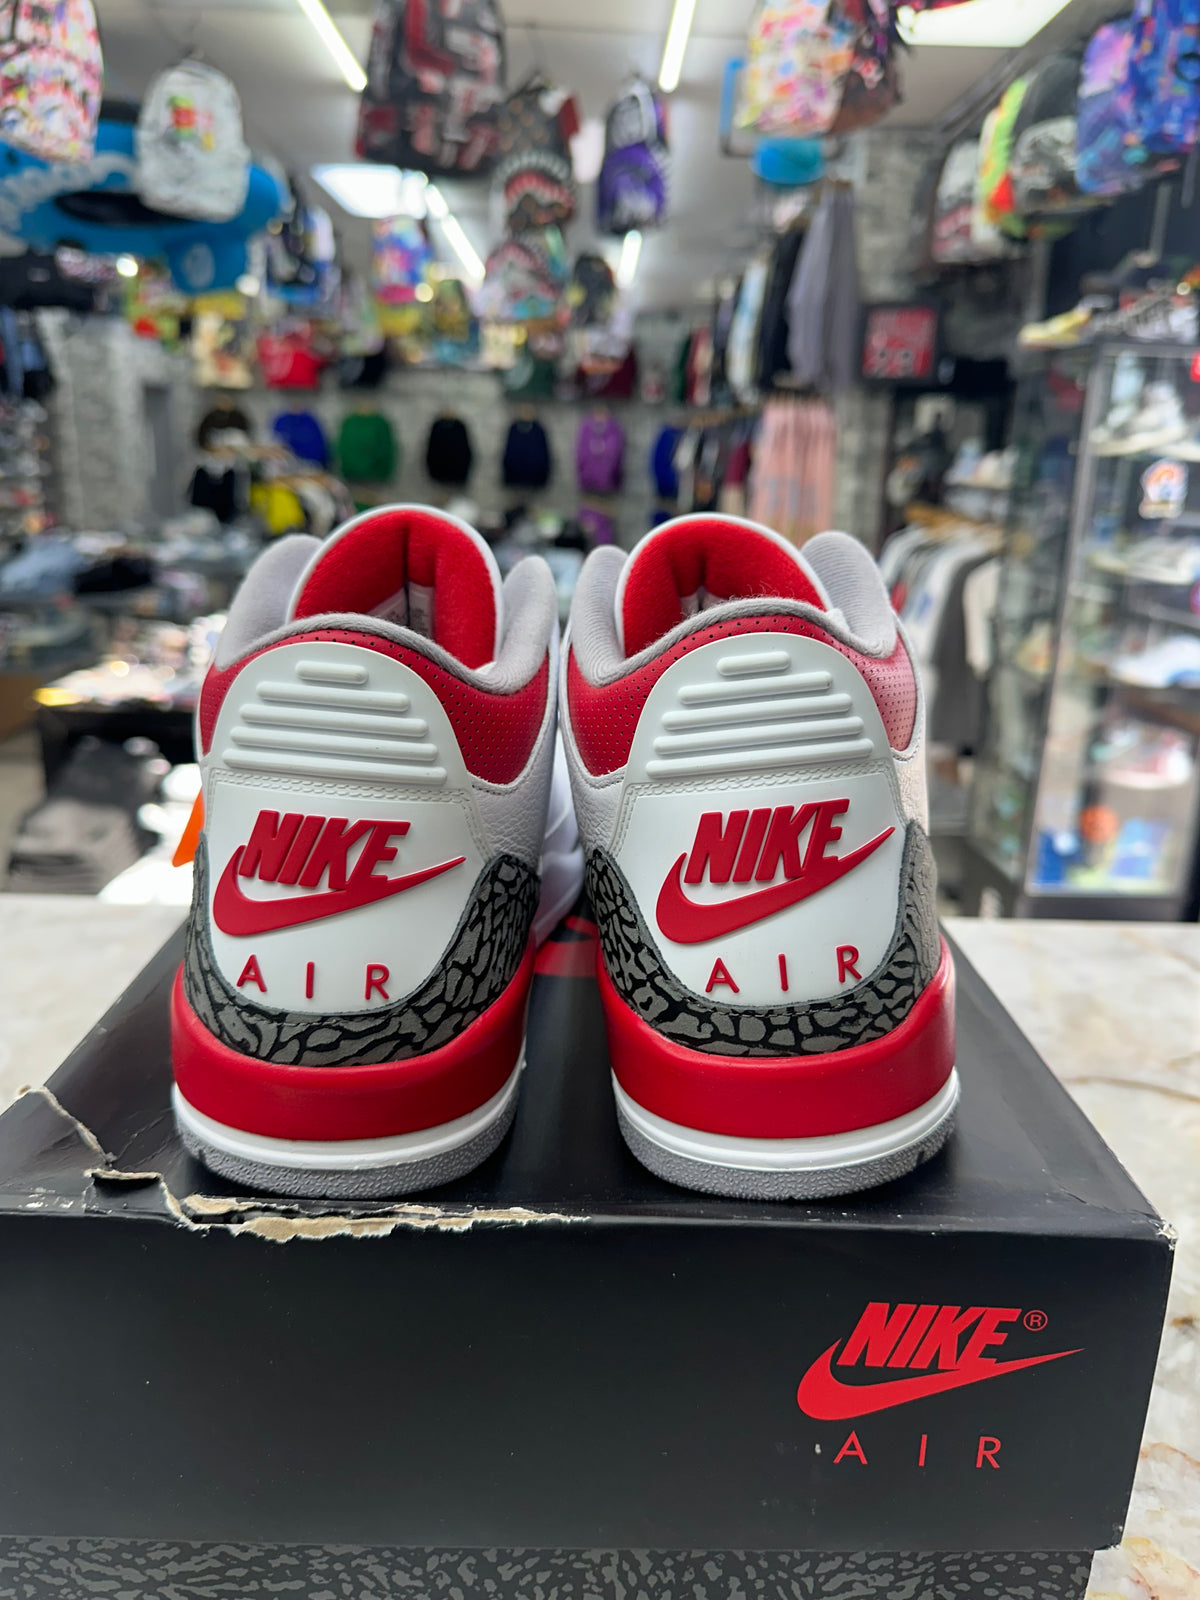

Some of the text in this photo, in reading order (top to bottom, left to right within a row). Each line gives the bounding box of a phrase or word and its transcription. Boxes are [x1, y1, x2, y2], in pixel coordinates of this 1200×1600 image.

[238, 809, 411, 890] NIKE
[684, 798, 850, 883] NIKE
[236, 954, 390, 1001] AIR
[705, 944, 863, 994] AIR
[832, 1430, 1002, 1469] AIR
